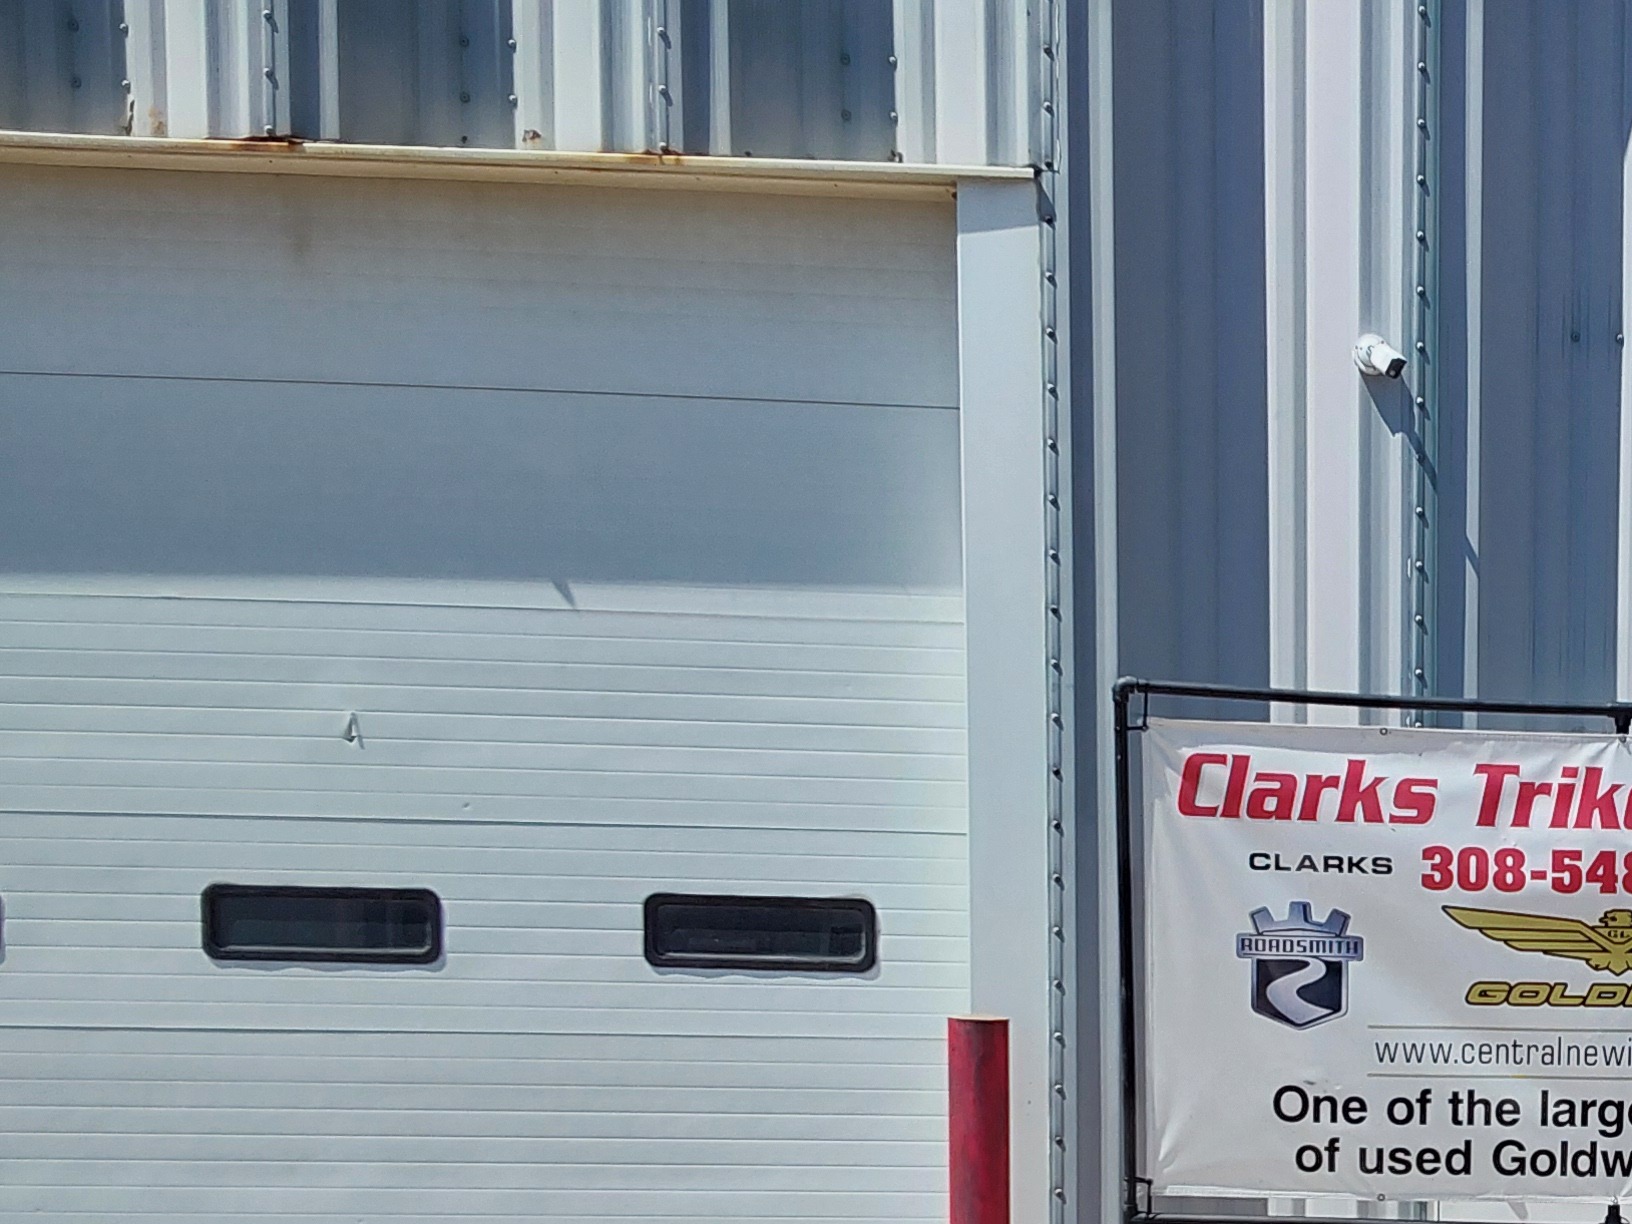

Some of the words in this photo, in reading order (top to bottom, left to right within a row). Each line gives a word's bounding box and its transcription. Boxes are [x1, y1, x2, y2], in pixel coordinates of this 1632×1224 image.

[1177, 753, 1438, 825] Clarks
[1249, 852, 1393, 874] CLARKS
[1240, 937, 1359, 955] ROADSMITH
[1272, 1084, 1368, 1125] One
[1386, 1087, 1432, 1126] of
[1447, 1089, 1521, 1127] the
[1295, 1138, 1340, 1173] of
[1359, 1140, 1472, 1176] used
